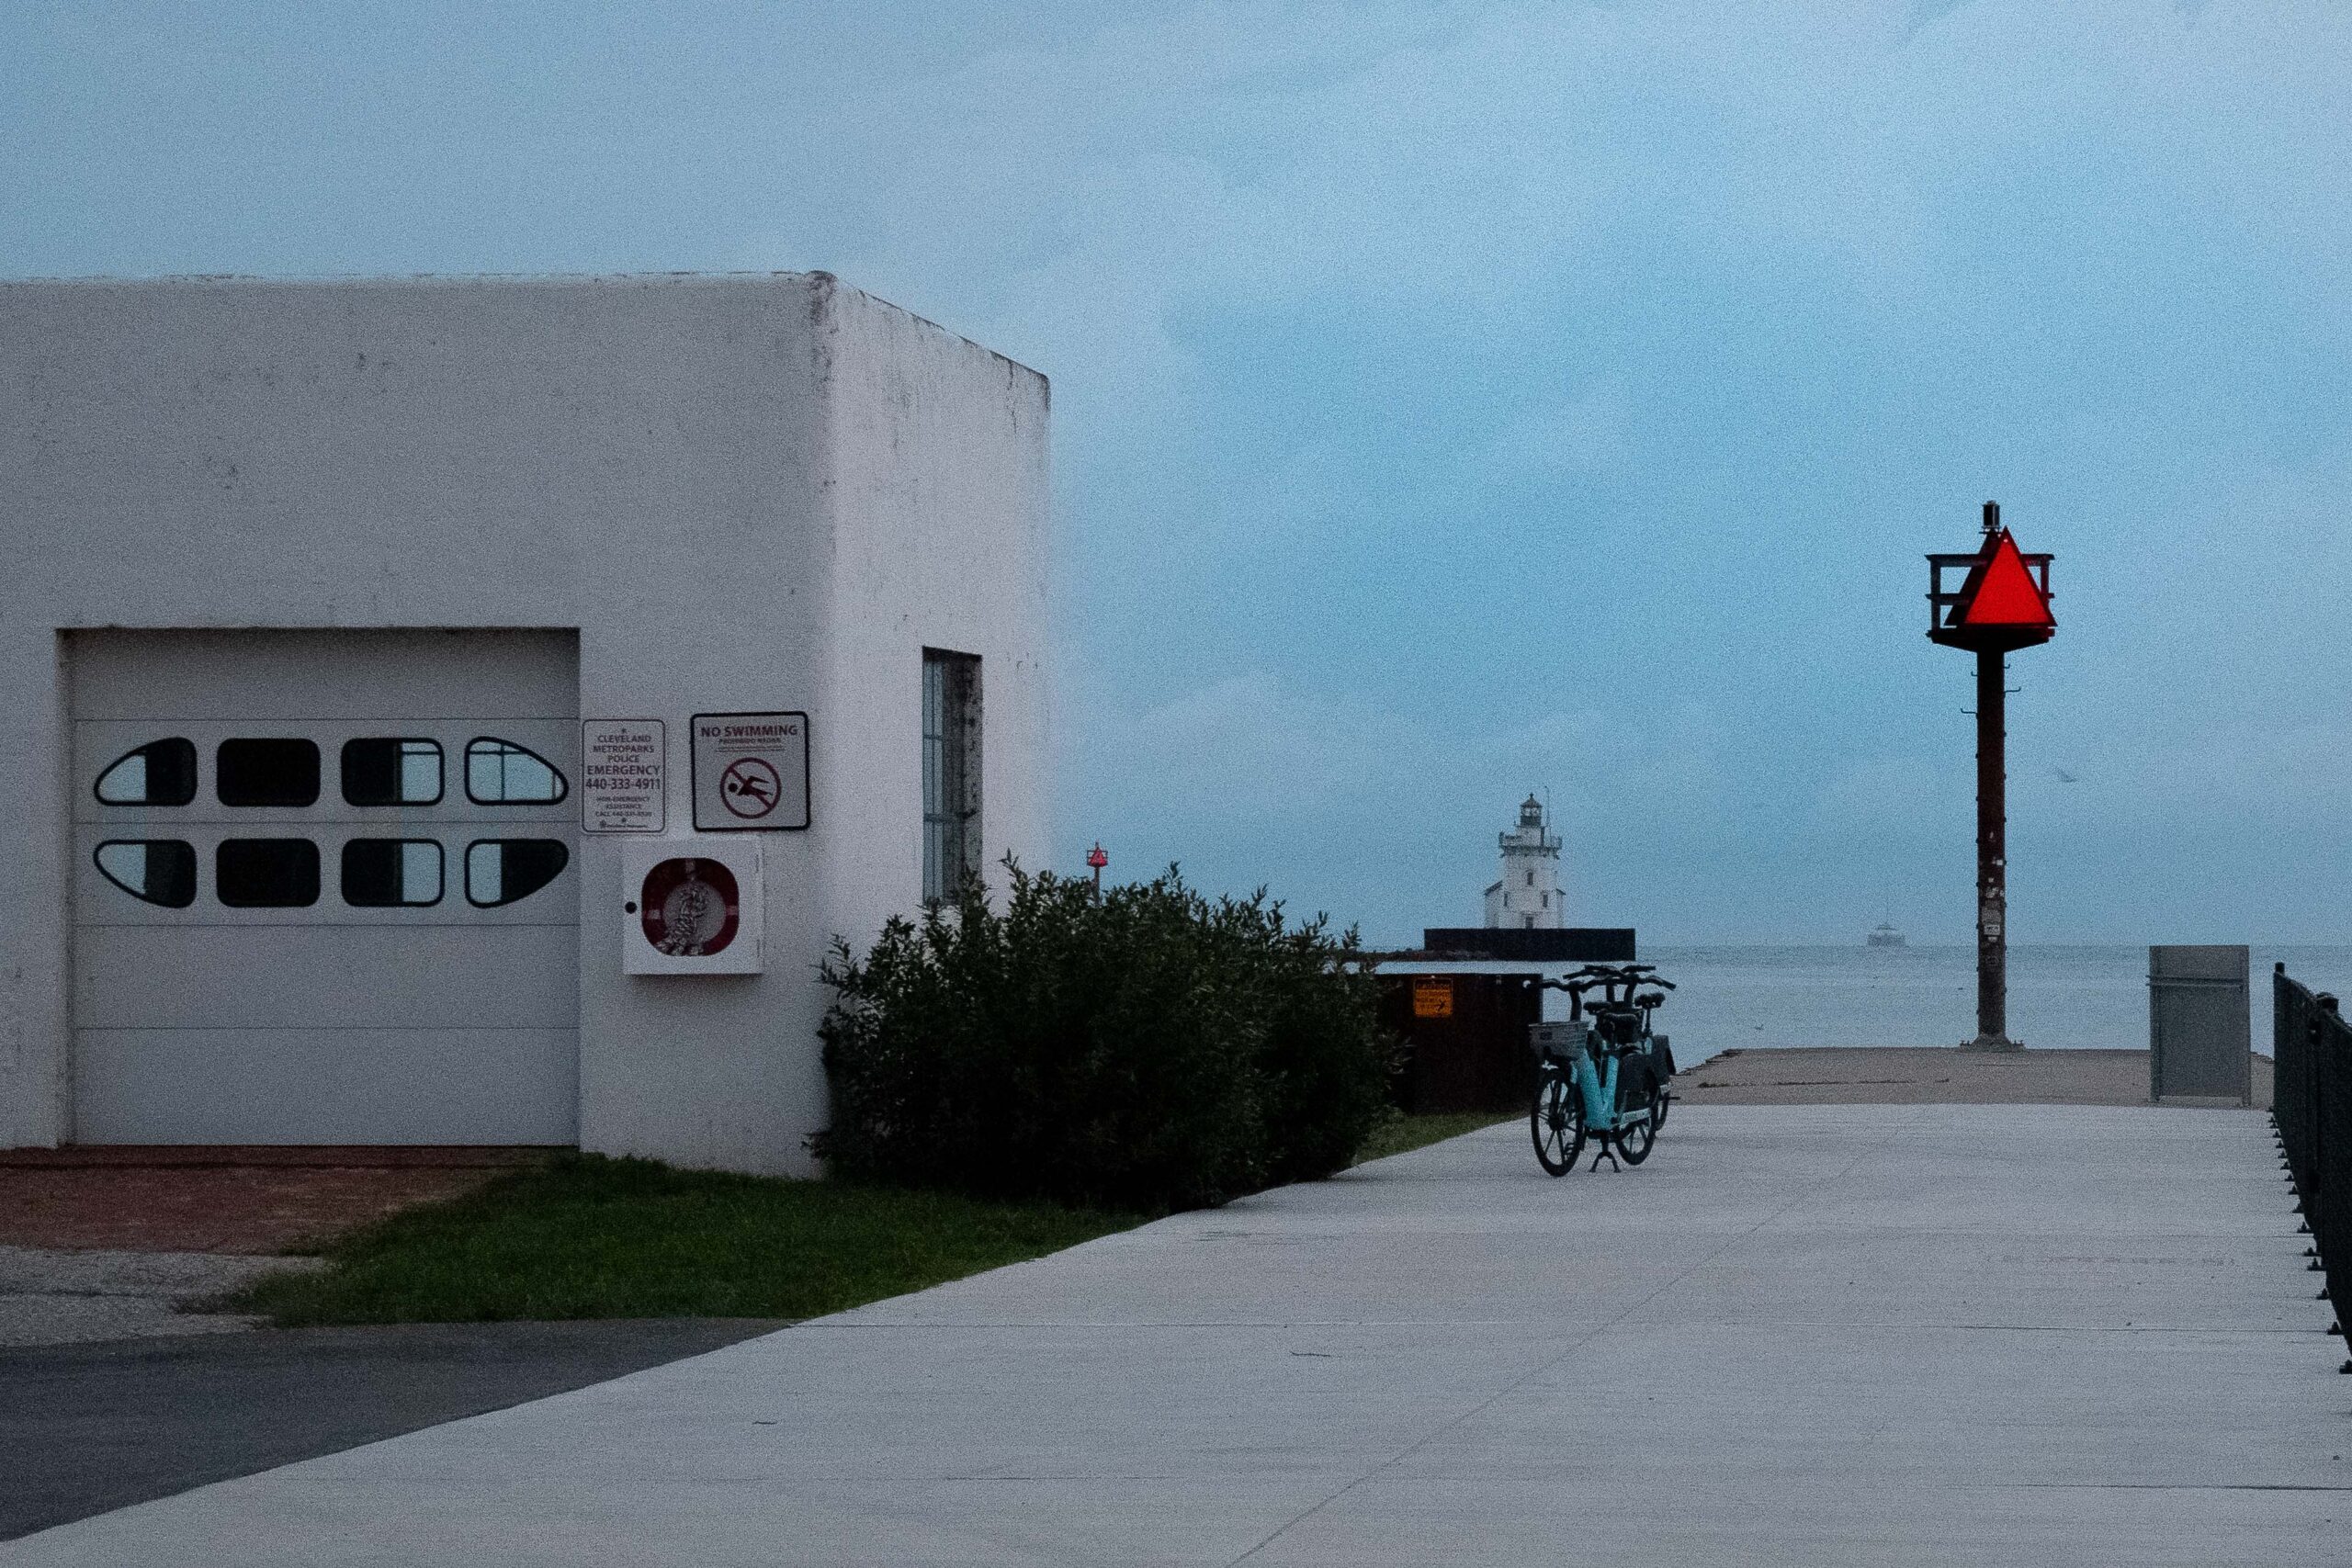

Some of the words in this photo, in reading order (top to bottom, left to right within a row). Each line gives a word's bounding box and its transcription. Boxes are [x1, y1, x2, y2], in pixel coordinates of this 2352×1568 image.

[701, 728, 721, 738] NO
[724, 725, 797, 737] SWIMMING
[597, 735, 652, 743] CLEVELAND
[593, 745, 655, 753] METROPARKS
[607, 754, 639, 763] POLICE
[586, 765, 661, 775] EMERGENCY
[585, 778, 661, 790] 440-333-4911
